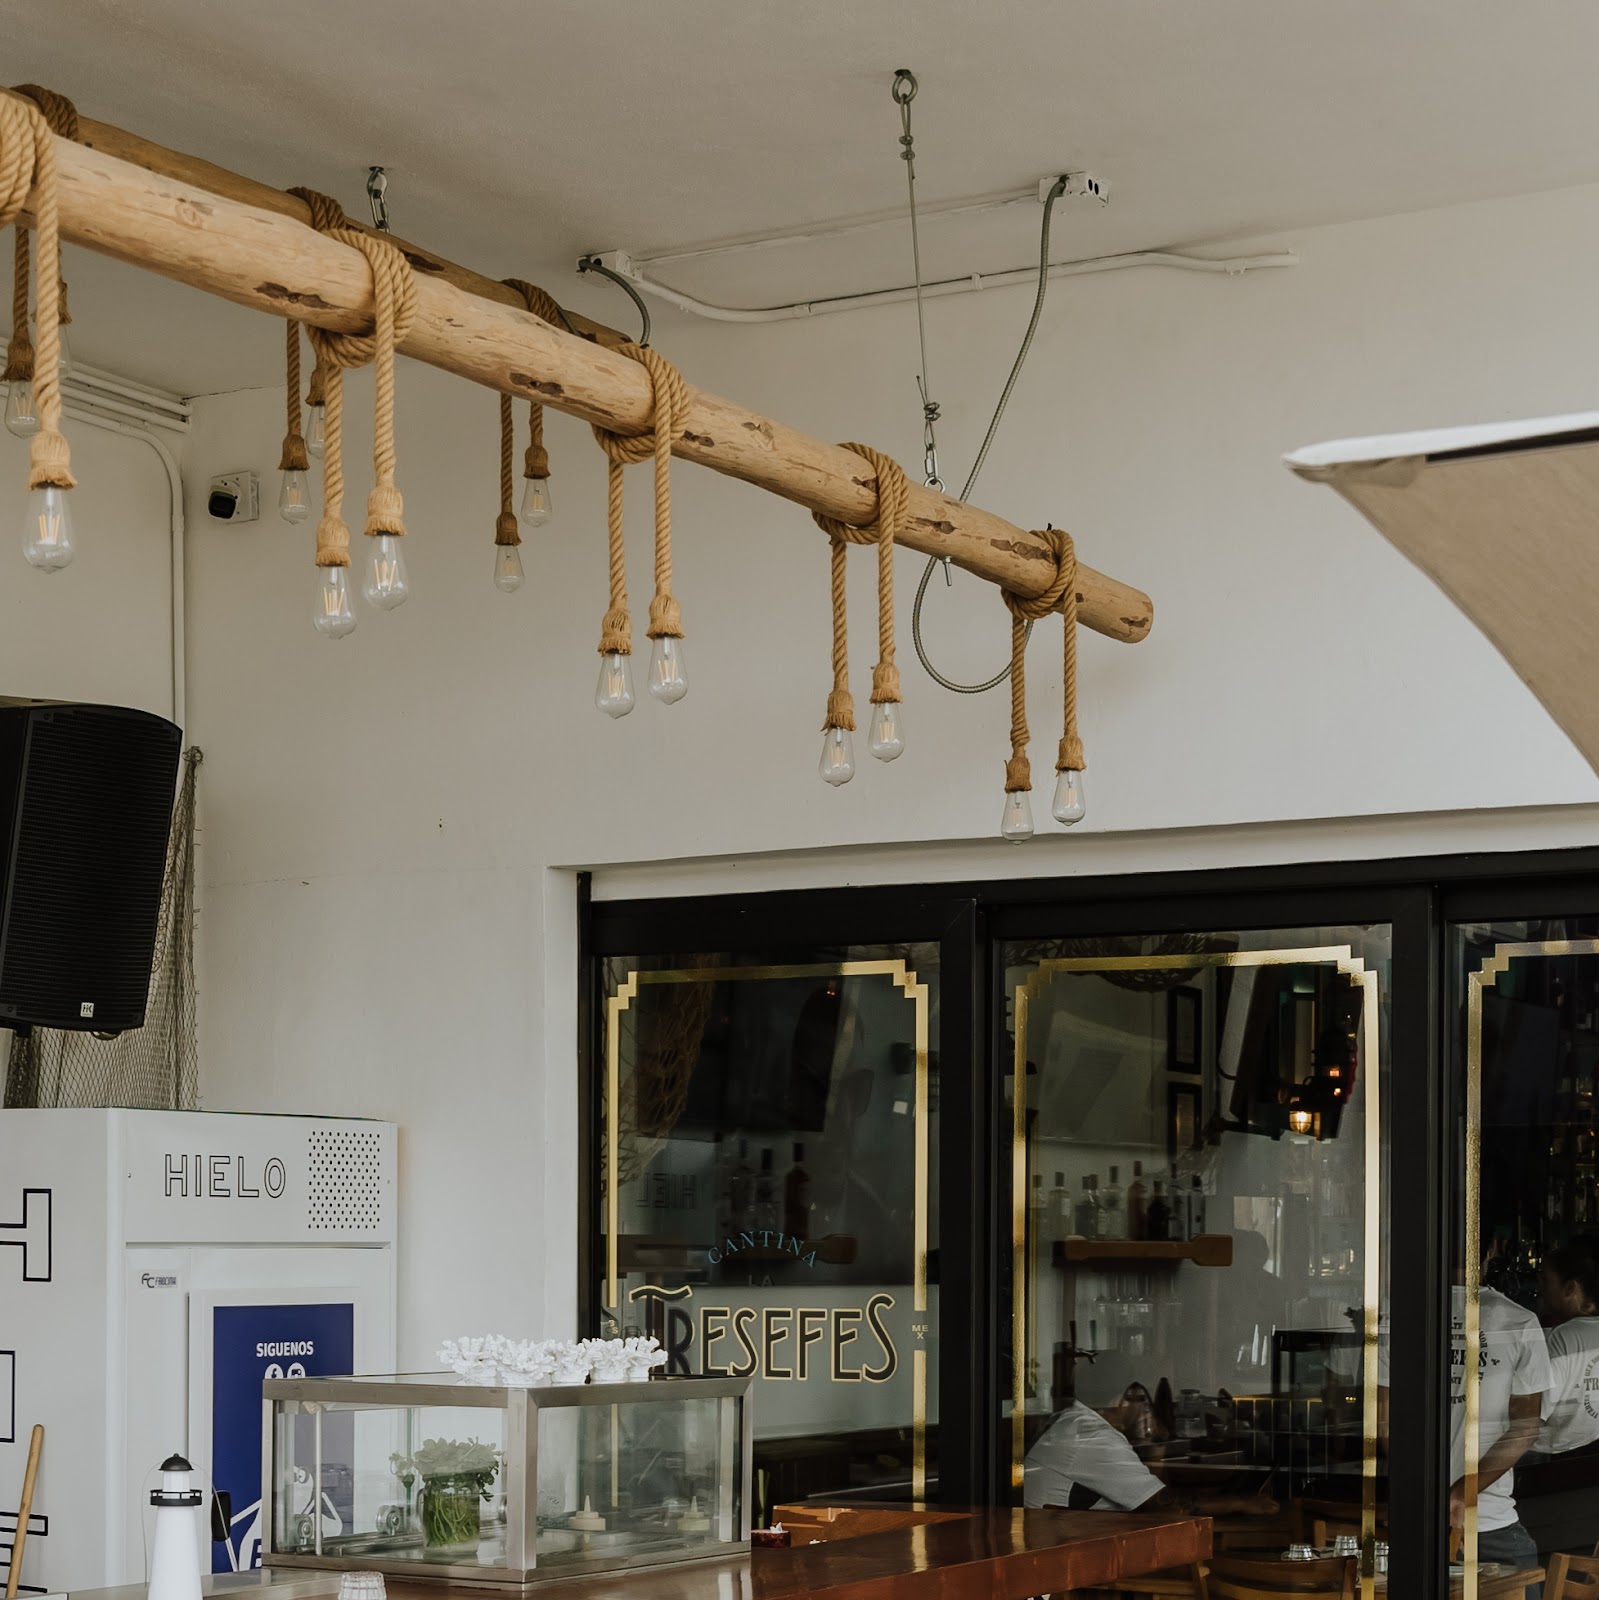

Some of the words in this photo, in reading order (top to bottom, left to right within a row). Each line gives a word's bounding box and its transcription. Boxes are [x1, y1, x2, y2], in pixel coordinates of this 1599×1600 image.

[164, 1153, 287, 1198] HIELO
[707, 1230, 818, 1269] CANTINA
[628, 1284, 899, 1384] TRESEFES
[911, 1324, 929, 1332] ME
[916, 1331, 924, 1340] X
[256, 1341, 314, 1358] SIGUENOS
